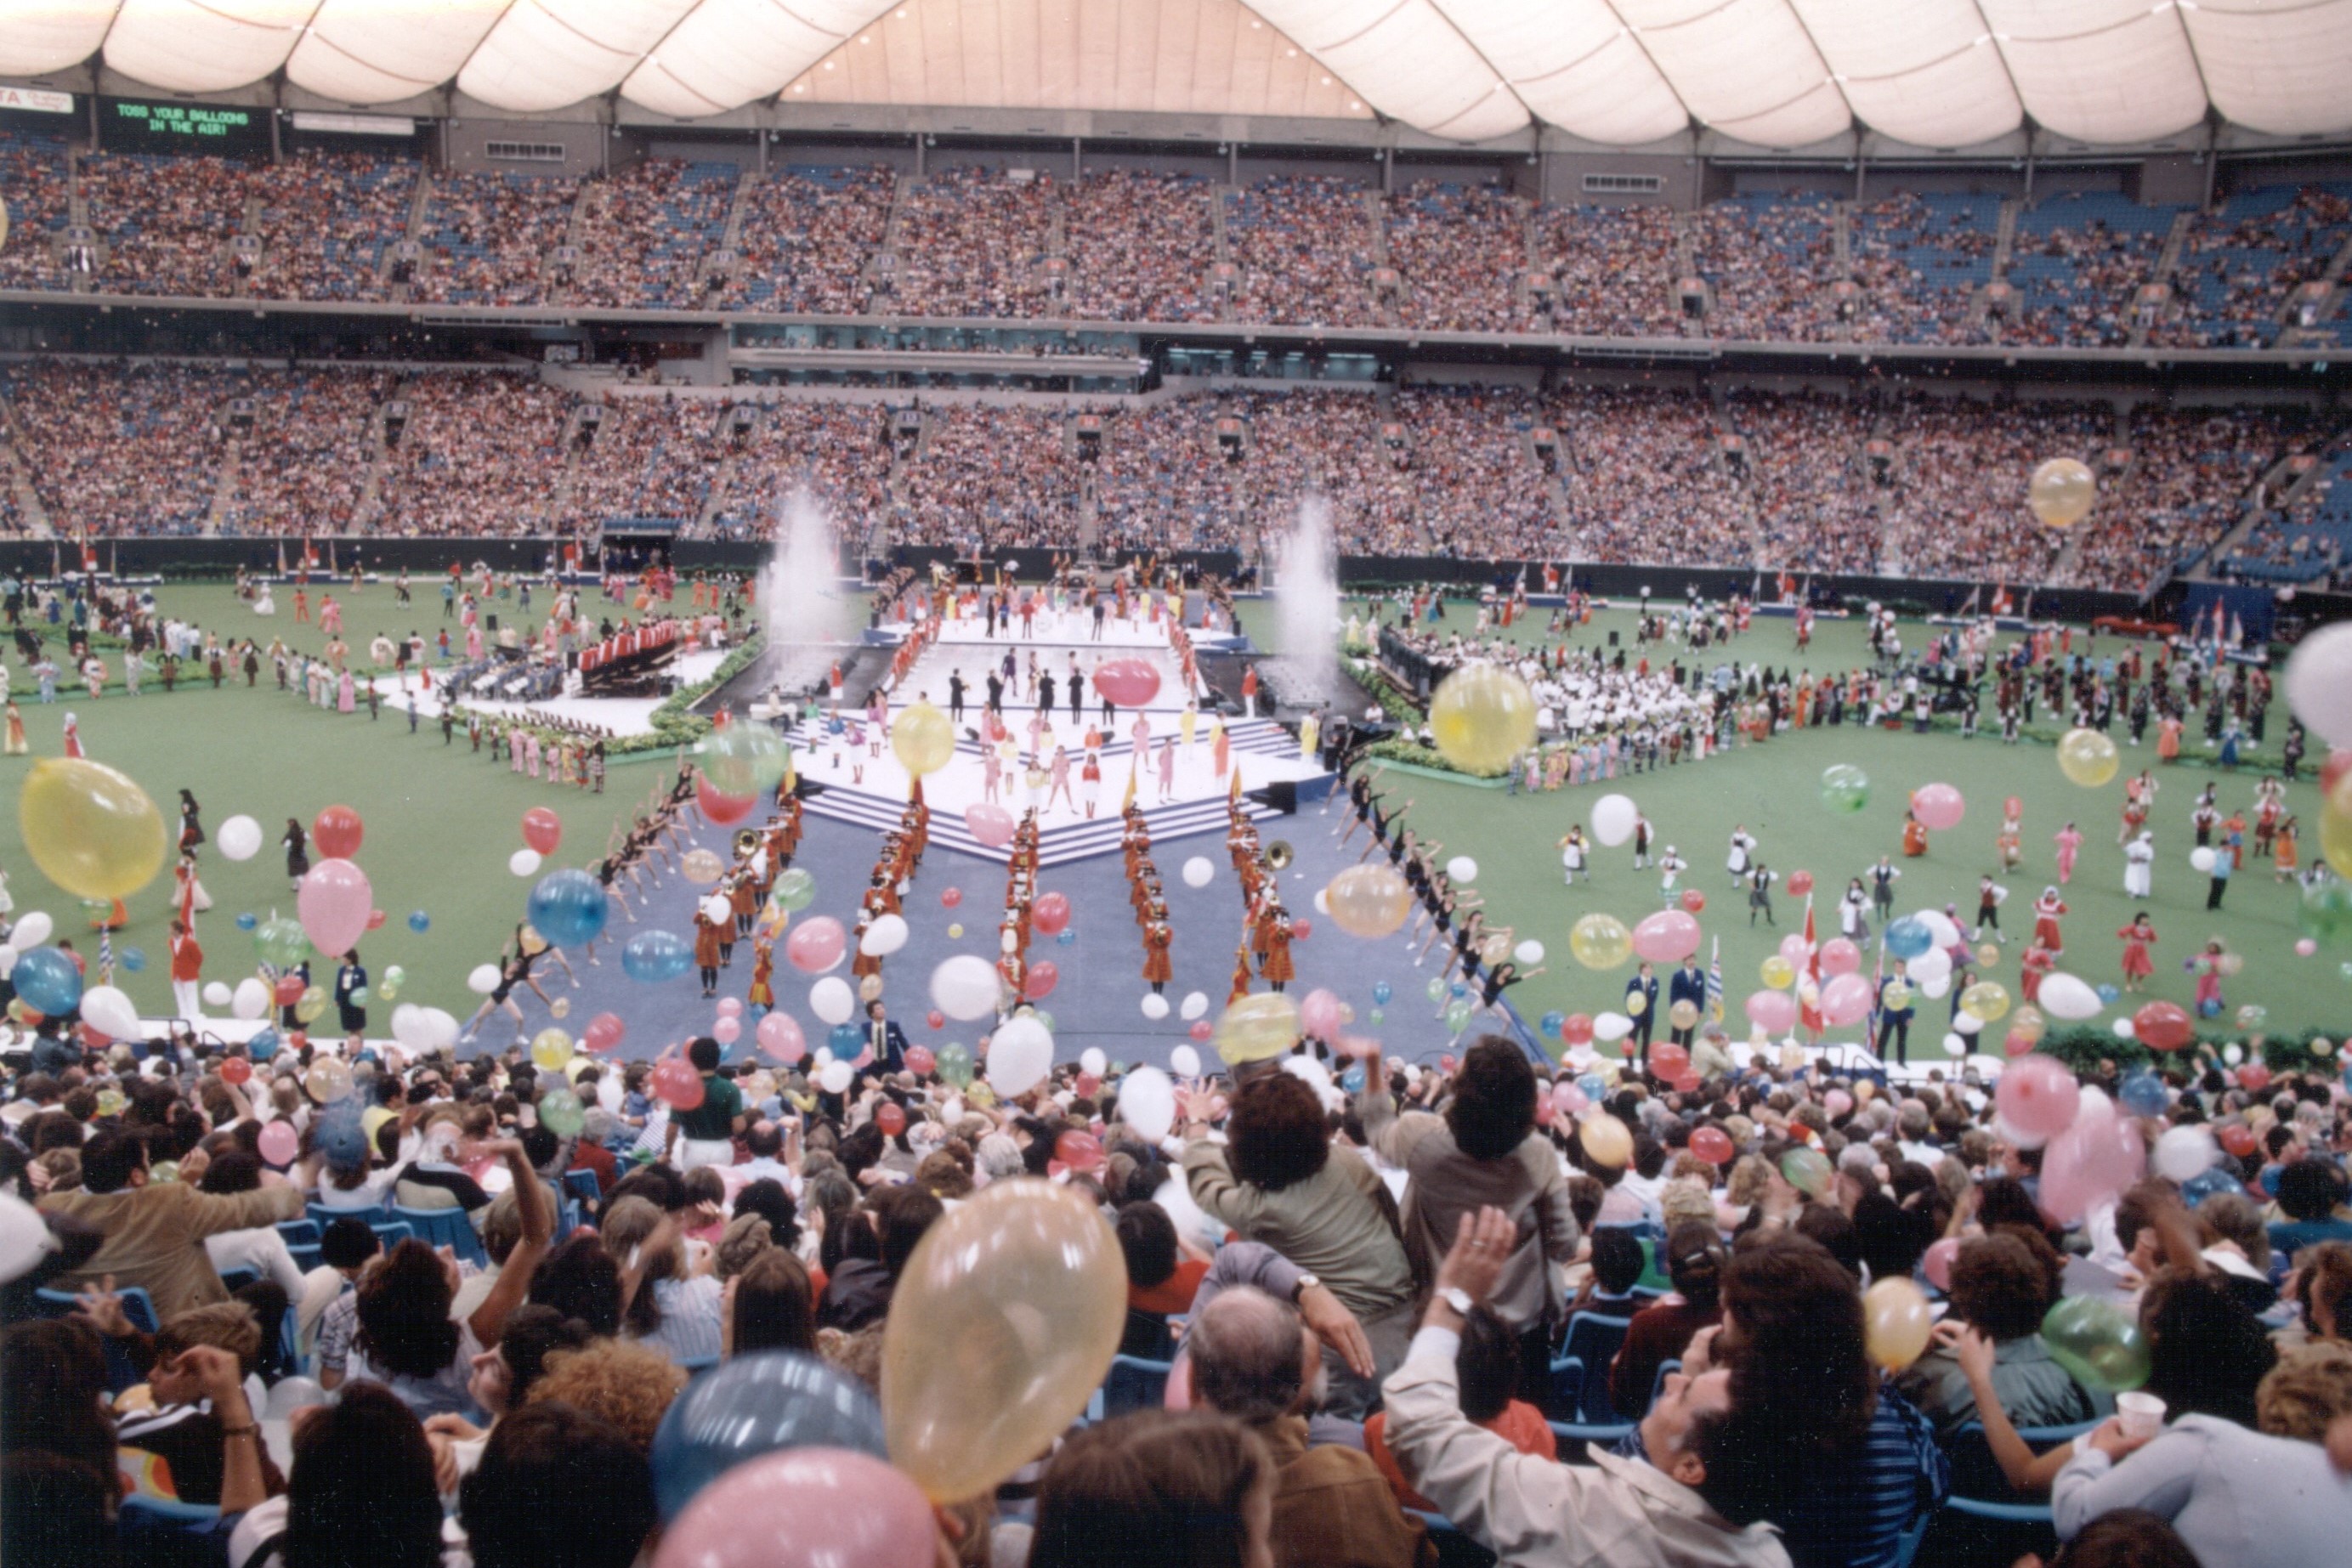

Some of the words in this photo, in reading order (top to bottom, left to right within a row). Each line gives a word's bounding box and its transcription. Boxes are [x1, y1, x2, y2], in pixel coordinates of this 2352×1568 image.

[117, 104, 148, 117] TOSS
[153, 107, 184, 120] YOUR
[189, 109, 248, 125] BALLOONS
[149, 119, 165, 131] IN
[170, 121, 193, 133] THE
[197, 123, 226, 135] AIR!
